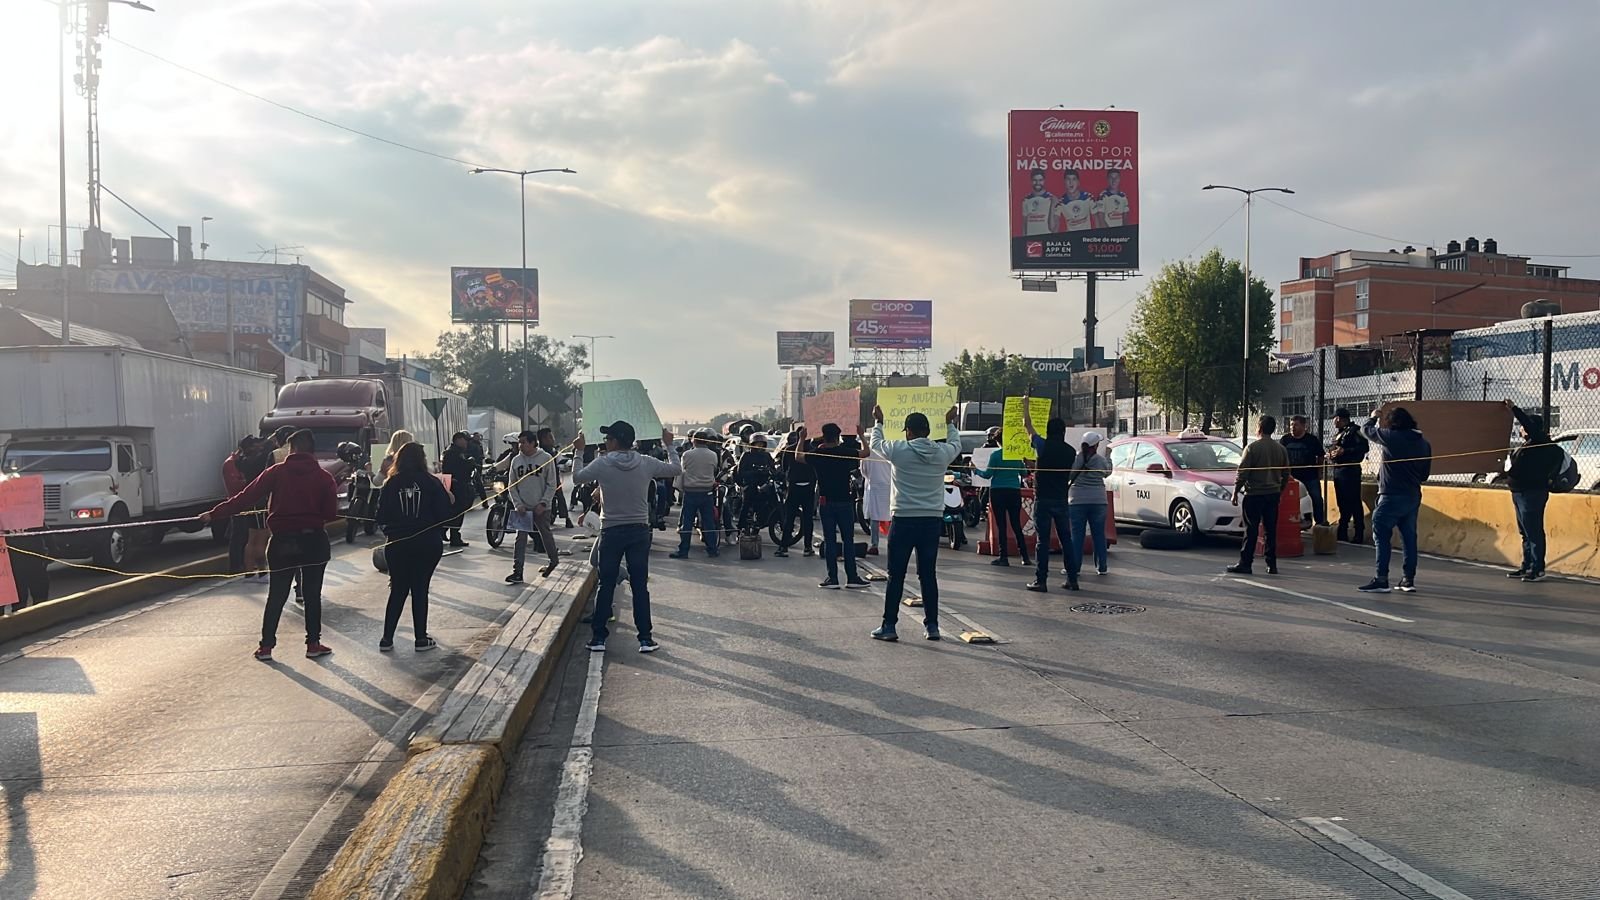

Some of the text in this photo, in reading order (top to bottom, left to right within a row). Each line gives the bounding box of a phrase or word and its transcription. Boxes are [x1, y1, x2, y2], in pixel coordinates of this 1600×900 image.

[1039, 116, 1085, 132] Caliente
[1016, 146, 1132, 157] JUGAMOS POR
[1016, 156, 1133, 170] MÁS GRANDEZA
[871, 302, 914, 312] CHOPO
[1031, 360, 1072, 372] Comex
[1136, 490, 1150, 500] TAXI
